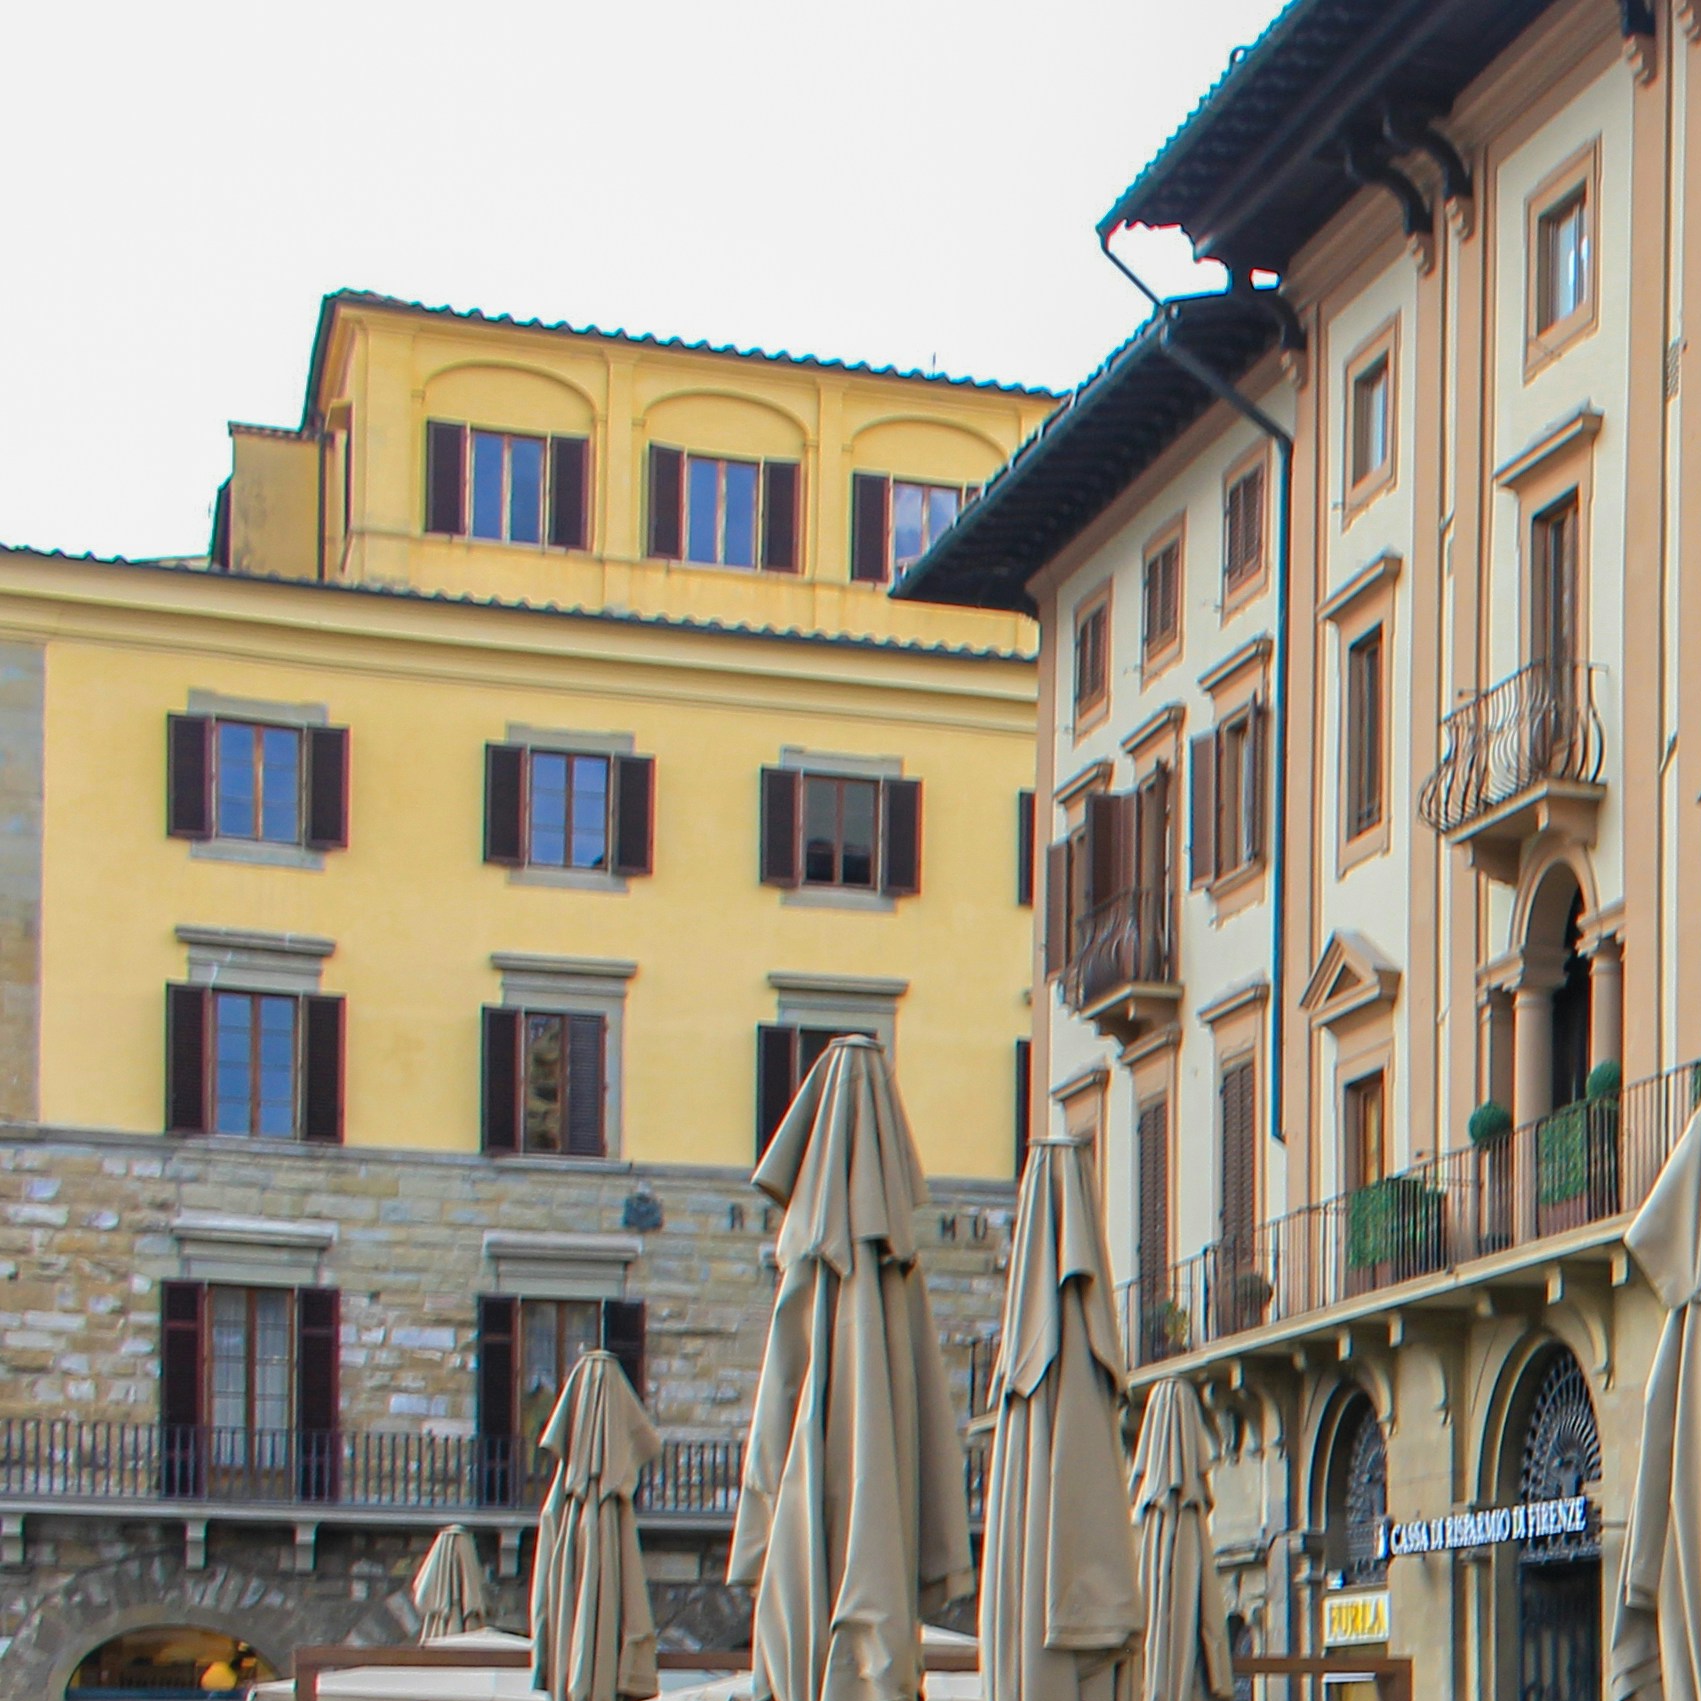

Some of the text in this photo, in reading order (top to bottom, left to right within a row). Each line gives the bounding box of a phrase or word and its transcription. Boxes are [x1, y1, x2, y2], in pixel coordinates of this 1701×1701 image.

[1390, 1495, 1588, 1555] CASSA DI RISPARMIO DI FIRENZE
